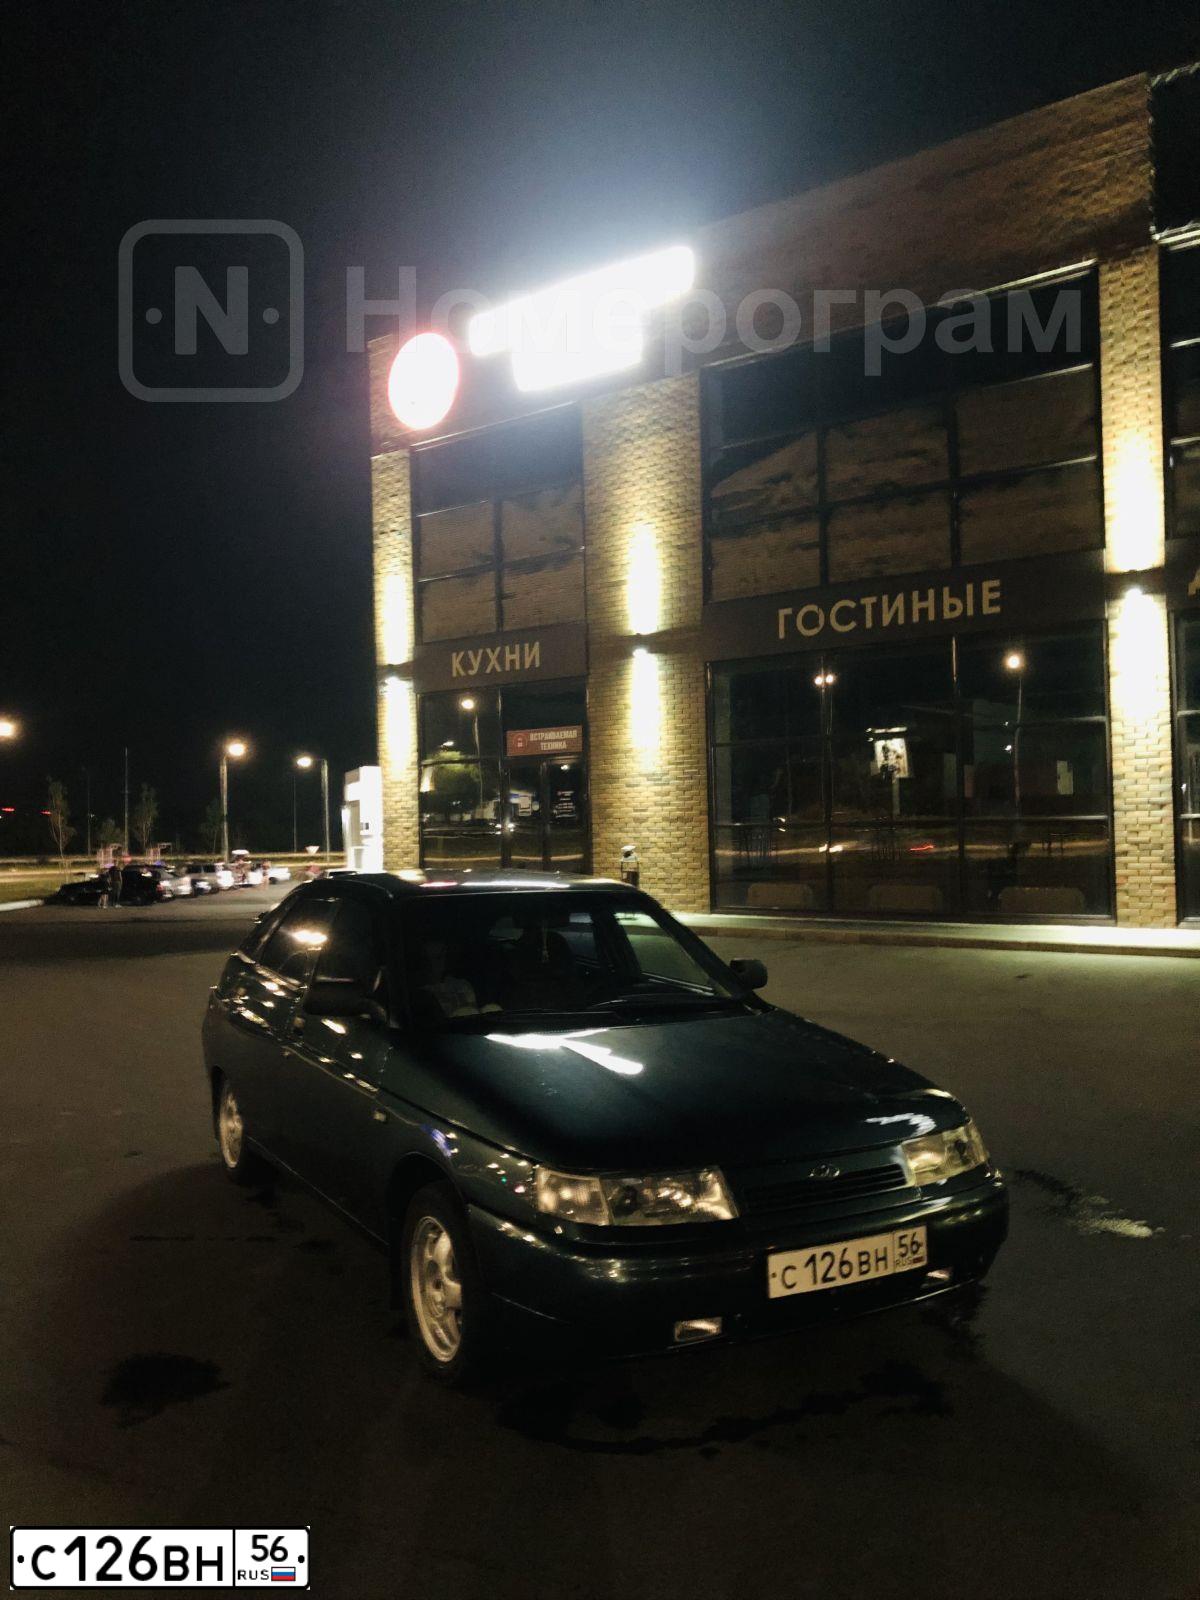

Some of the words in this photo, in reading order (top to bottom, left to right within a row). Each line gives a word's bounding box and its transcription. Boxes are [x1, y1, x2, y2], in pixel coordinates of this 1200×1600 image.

[776, 578, 1003, 640] ГОСТИНЫЕ
[451, 641, 541, 678] КУХНИ
[897, 1231, 920, 1258] 56
[895, 1257, 912, 1268] RUS
